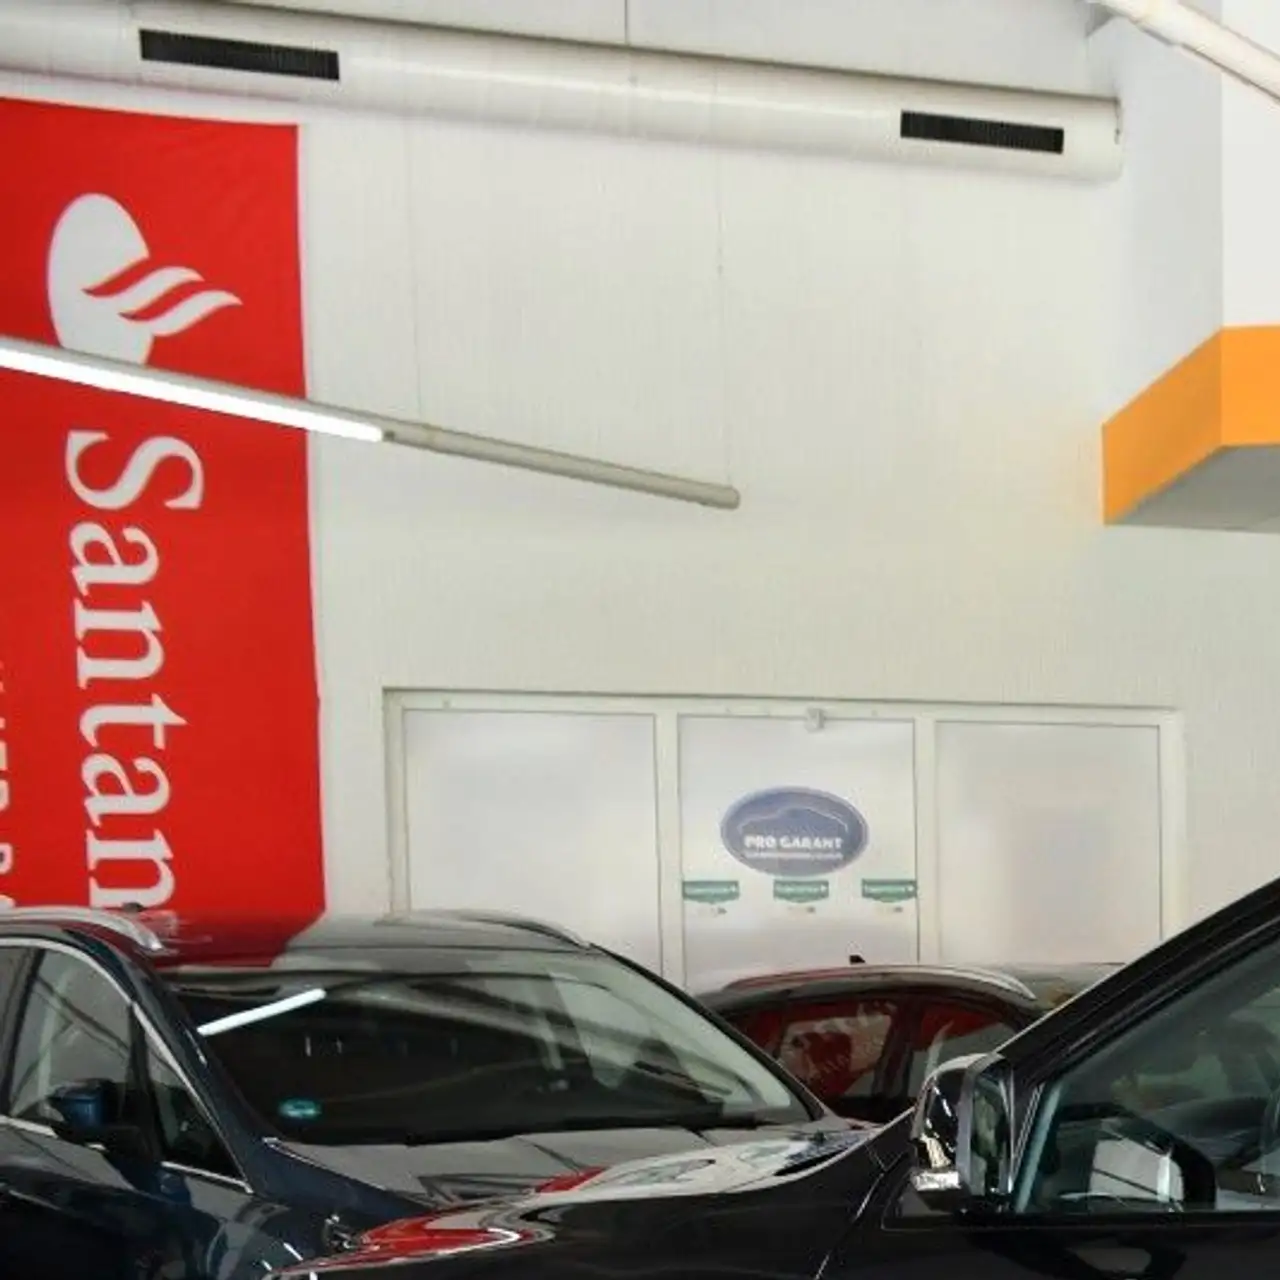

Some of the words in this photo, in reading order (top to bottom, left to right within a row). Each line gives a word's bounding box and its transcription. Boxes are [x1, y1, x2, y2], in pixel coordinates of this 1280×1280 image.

[65, 430, 204, 908] Santan
[744, 834, 776, 849] PRO
[780, 835, 843, 850] GARANT
